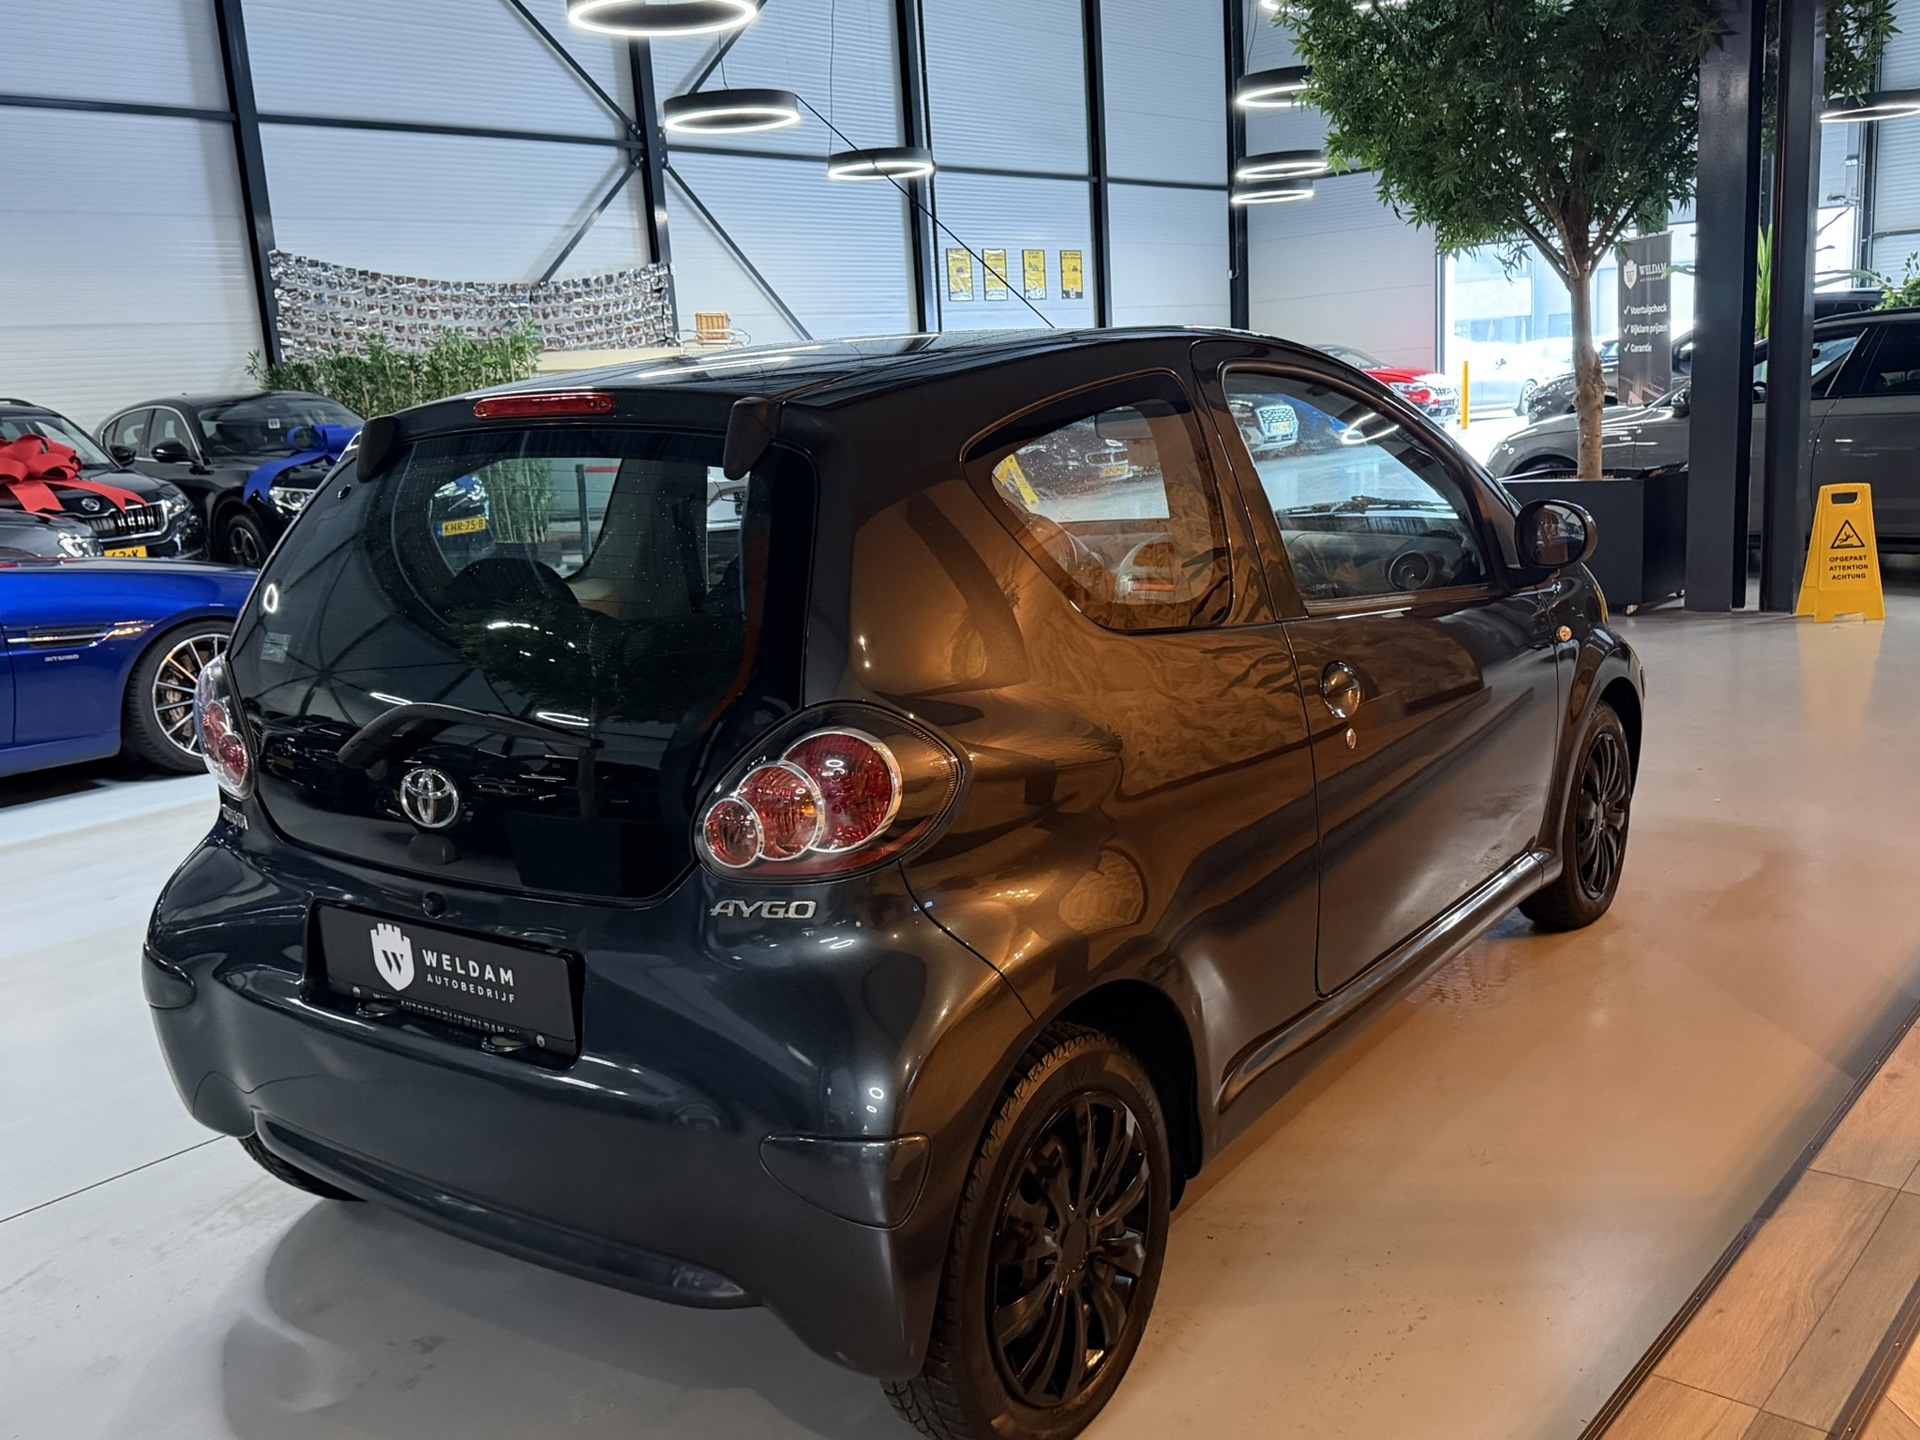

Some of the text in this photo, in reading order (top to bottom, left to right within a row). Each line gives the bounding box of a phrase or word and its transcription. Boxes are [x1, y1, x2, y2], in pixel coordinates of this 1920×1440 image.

[1829, 555, 1867, 563] OPGEPAST
[1829, 564, 1869, 572] ATTENTION
[1831, 573, 1867, 581] ACHTUNG
[709, 899, 817, 919] AYGO
[422, 948, 514, 987] WELDAM
[426, 973, 515, 1003] AUTOBEDRIJF
